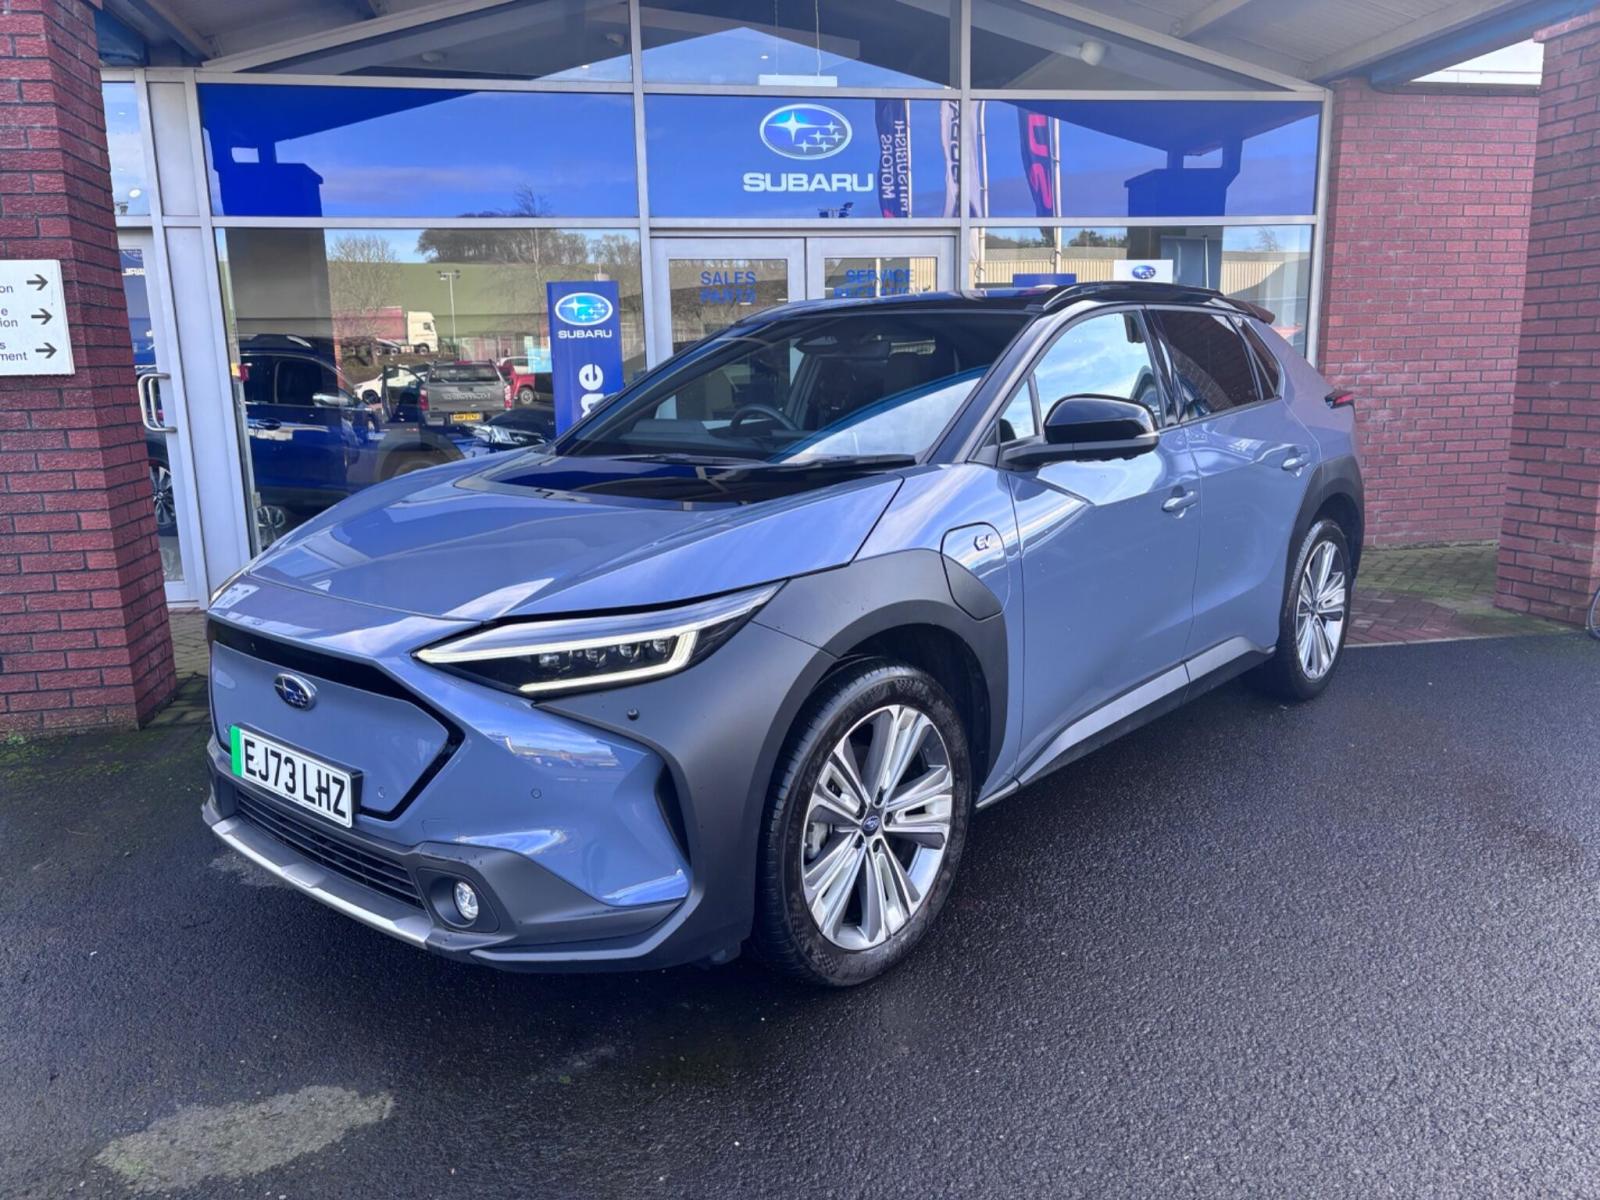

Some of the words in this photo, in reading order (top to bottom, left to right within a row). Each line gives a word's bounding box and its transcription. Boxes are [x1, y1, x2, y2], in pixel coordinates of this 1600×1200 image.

[743, 172, 874, 192] SUBARU
[700, 271, 757, 286] SALES
[558, 329, 612, 339] SUBARU
[244, 738, 296, 795] EJ73
[302, 762, 347, 819] LHZ
